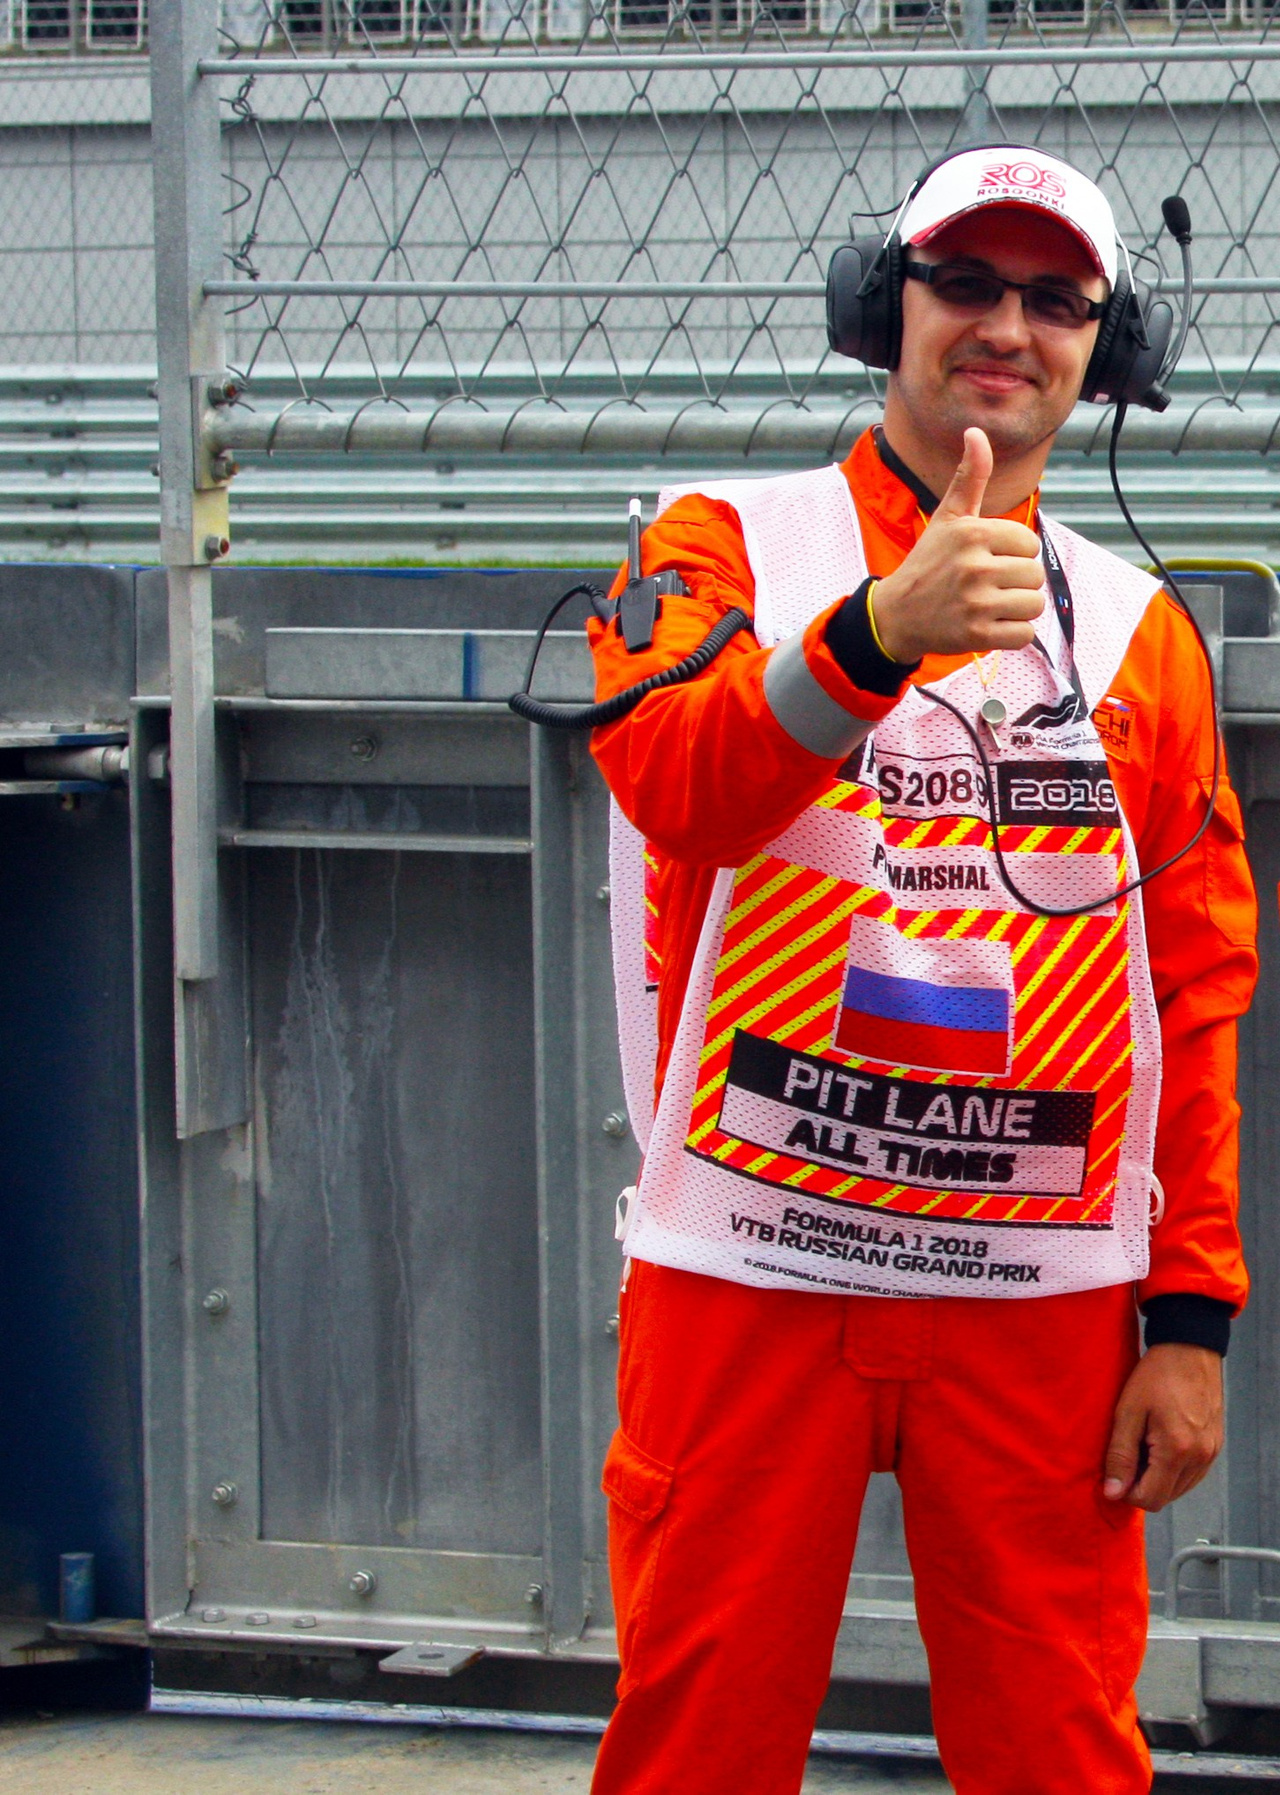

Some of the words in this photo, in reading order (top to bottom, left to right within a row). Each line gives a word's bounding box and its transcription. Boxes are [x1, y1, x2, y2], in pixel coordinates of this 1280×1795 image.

[1010, 779, 1117, 812] 2018
[888, 864, 990, 891] MARSHAL
[783, 1058, 873, 1117] PIT
[884, 1086, 1036, 1138] LANE
[784, 1119, 868, 1166] ALL
[879, 1139, 1017, 1183] TIMES
[731, 1212, 775, 1242] VTB
[778, 1228, 889, 1268] RUSSIAN
[893, 1253, 984, 1280] GRAND
[988, 1262, 1042, 1283] PRIX
[782, 1207, 906, 1250] FORMULA
[911, 1234, 924, 1252] 1
[928, 1236, 988, 1258] 2018
[853, 1283, 890, 1296] WORLD
